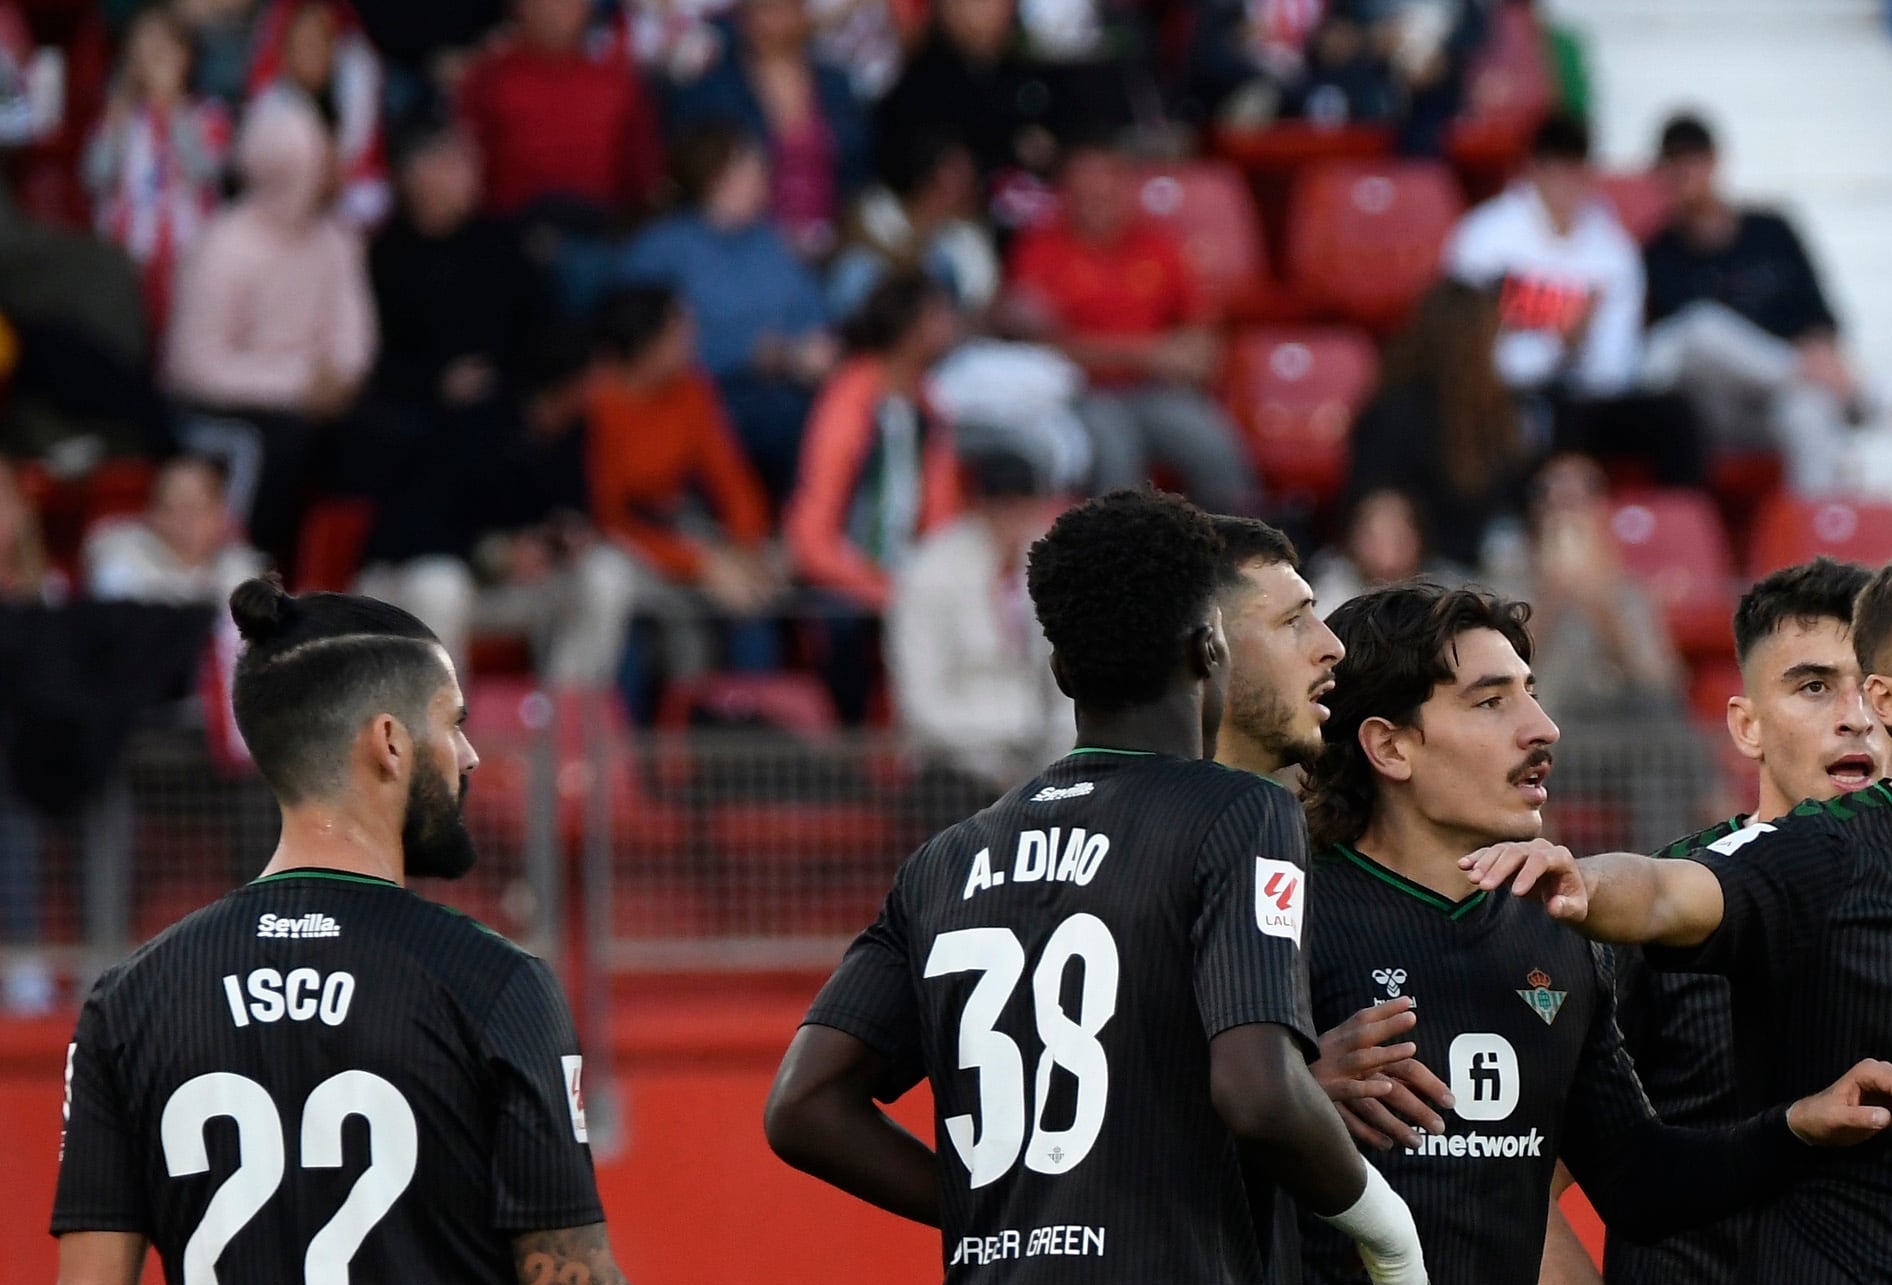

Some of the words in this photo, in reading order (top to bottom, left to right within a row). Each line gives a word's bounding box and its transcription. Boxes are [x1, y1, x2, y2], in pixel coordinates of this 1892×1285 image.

[964, 848, 1004, 900] A.
[1013, 827, 1111, 887] DIAO
[223, 967, 355, 1027] ISCO
[923, 912, 1120, 1190] 38
[1468, 1052, 1501, 1102] fi
[1026, 1224, 1105, 1258] GREEN
